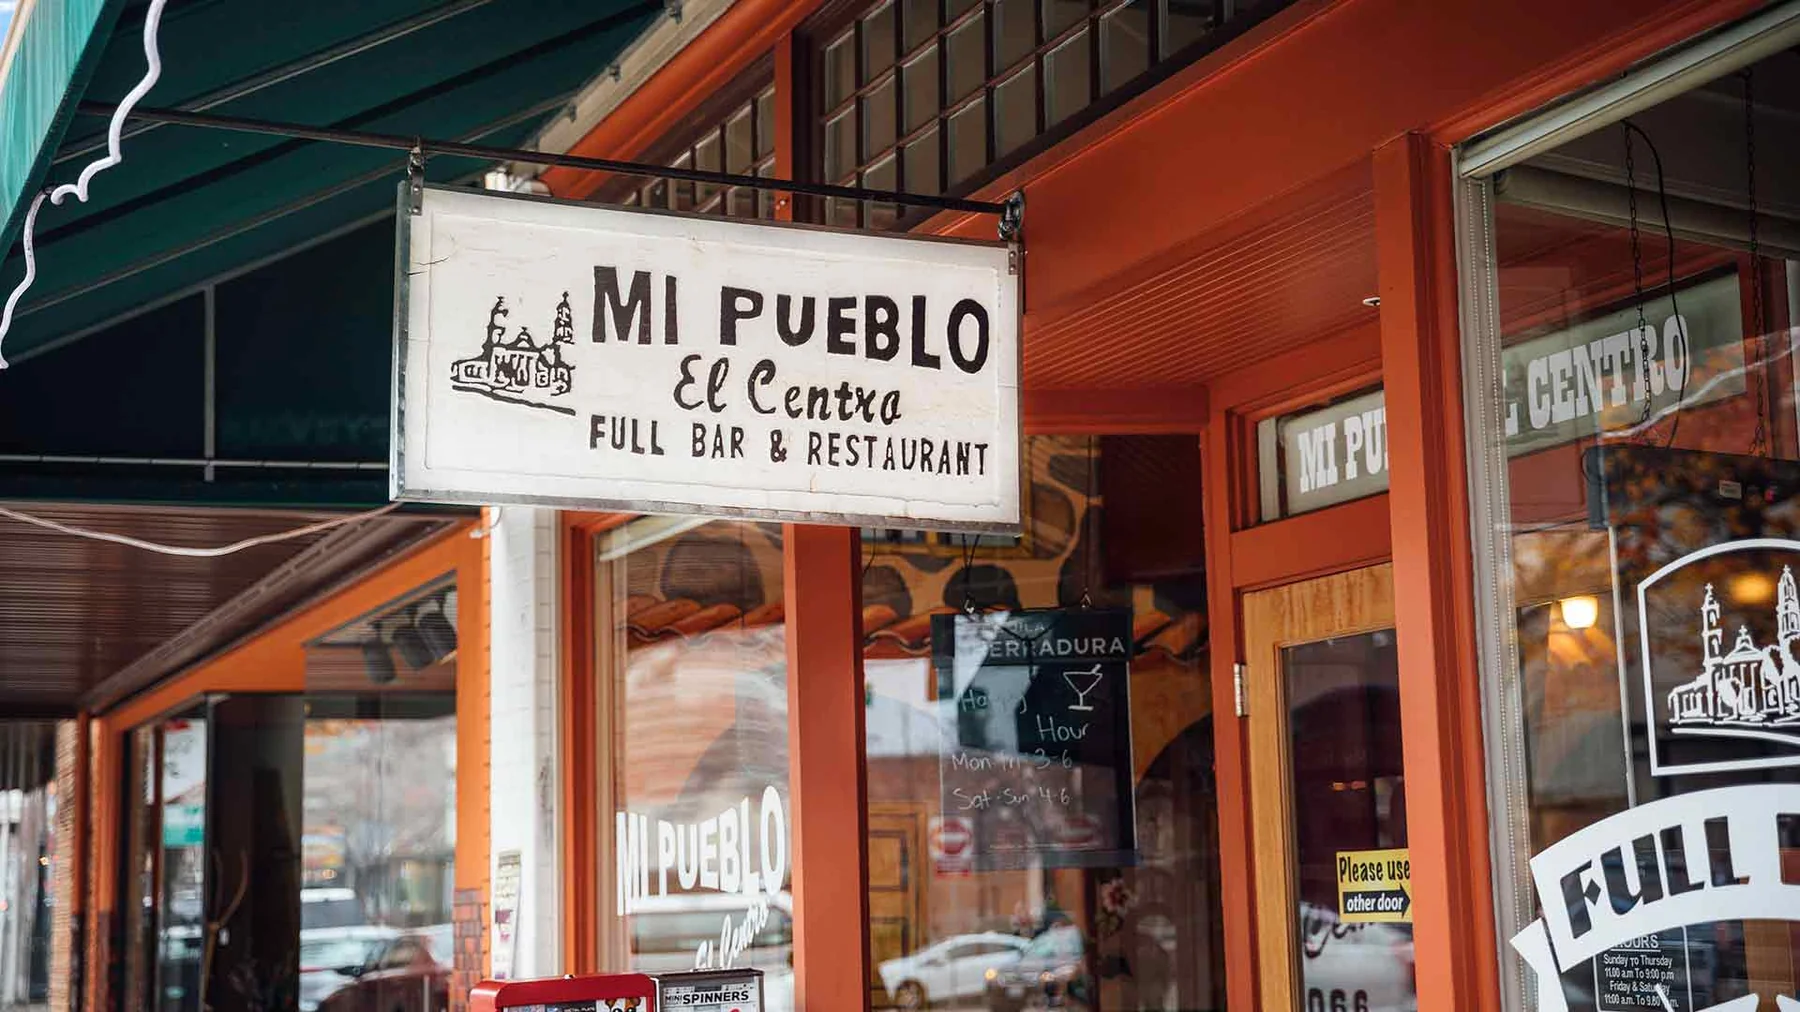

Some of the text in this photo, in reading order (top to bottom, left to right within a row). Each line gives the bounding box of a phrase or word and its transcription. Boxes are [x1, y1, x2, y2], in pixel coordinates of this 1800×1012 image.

[592, 265, 990, 375] MI PUEBLO
[1528, 315, 1690, 429] CENTRO
[673, 354, 902, 425] El Centro
[589, 414, 989, 476] FULL BAR & RESTAURANT
[1298, 406, 1389, 494] MI PU
[982, 636, 1126, 659] ERRADURA
[1036, 714, 1089, 742] Hour
[616, 811, 649, 916] MI
[658, 785, 786, 898] PUEBLO
[1339, 856, 1410, 883] Please use
[1560, 816, 1750, 940] FULL
[1346, 893, 1404, 912] other door
[1613, 934, 1660, 949] OURS
[1603, 953, 1628, 968] Sunday
[1640, 954, 1673, 969] Thursday
[683, 990, 749, 1005] SPINNERS
[1609, 980, 1631, 994] Friday
[1632, 982, 1639, 992] &
